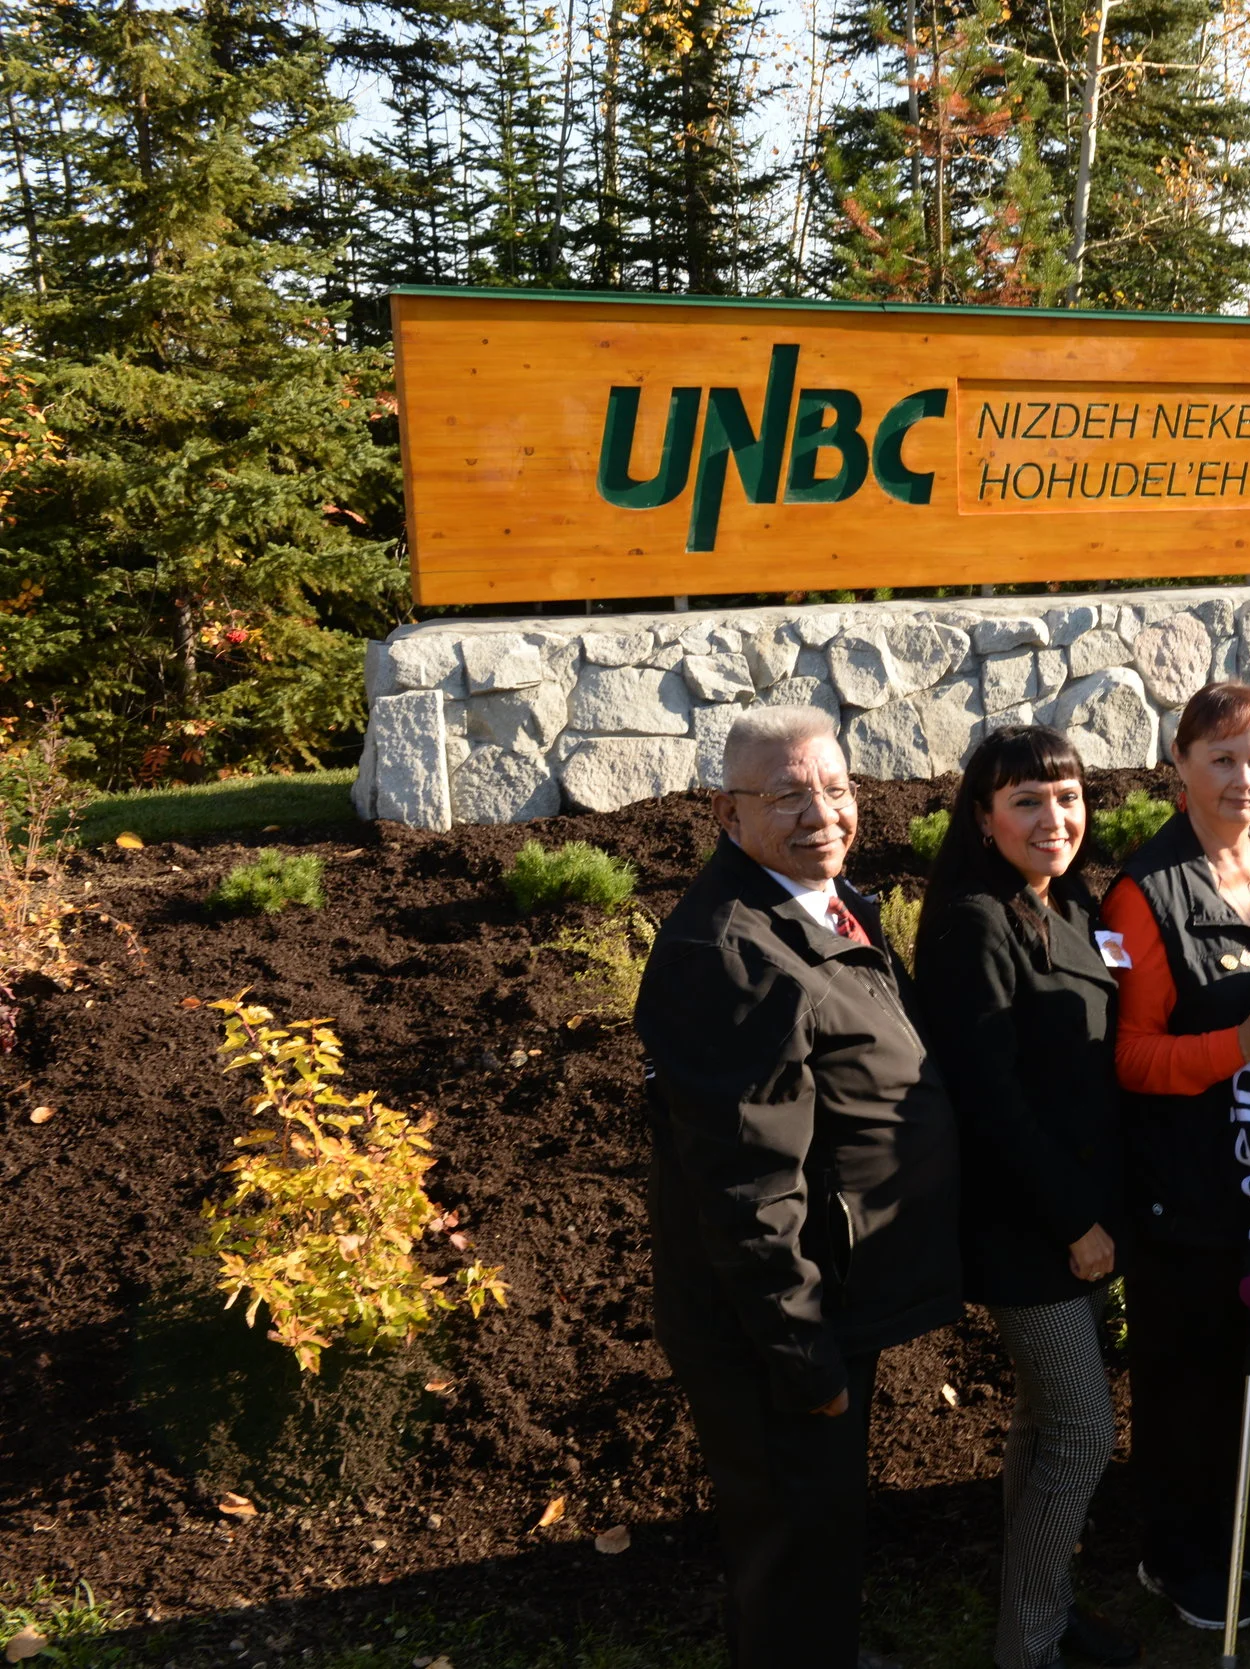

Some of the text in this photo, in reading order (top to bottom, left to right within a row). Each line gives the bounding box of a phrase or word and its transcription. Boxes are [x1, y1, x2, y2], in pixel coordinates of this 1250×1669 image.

[977, 402, 1139, 440] NIZDEH
[596, 343, 949, 554] UNBC
[978, 460, 1248, 501] HOHUDEL'EH
